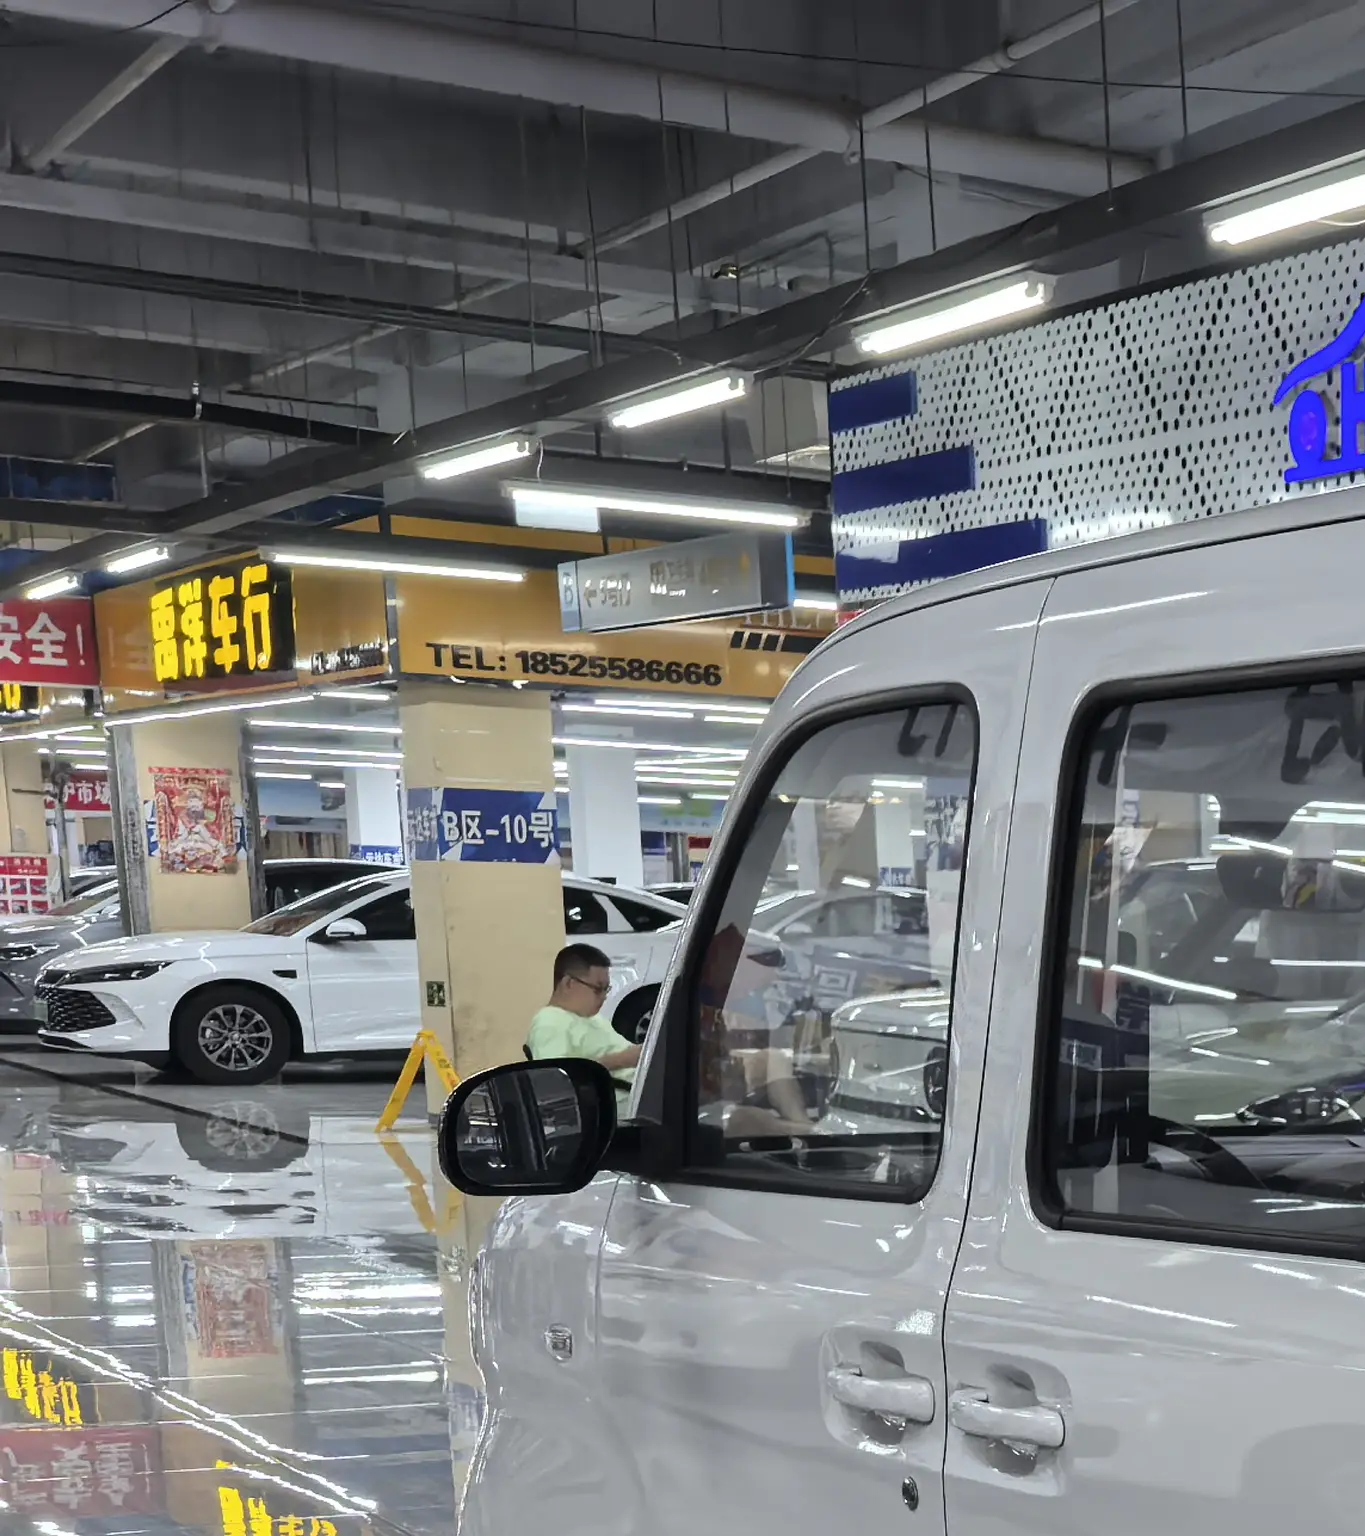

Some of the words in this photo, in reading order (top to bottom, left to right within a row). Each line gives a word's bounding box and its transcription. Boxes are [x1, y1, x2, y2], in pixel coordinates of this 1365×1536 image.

[426, 642, 507, 674] TEL:
[514, 650, 723, 687] 18525586666
[442, 810, 555, 848] B区-10号
